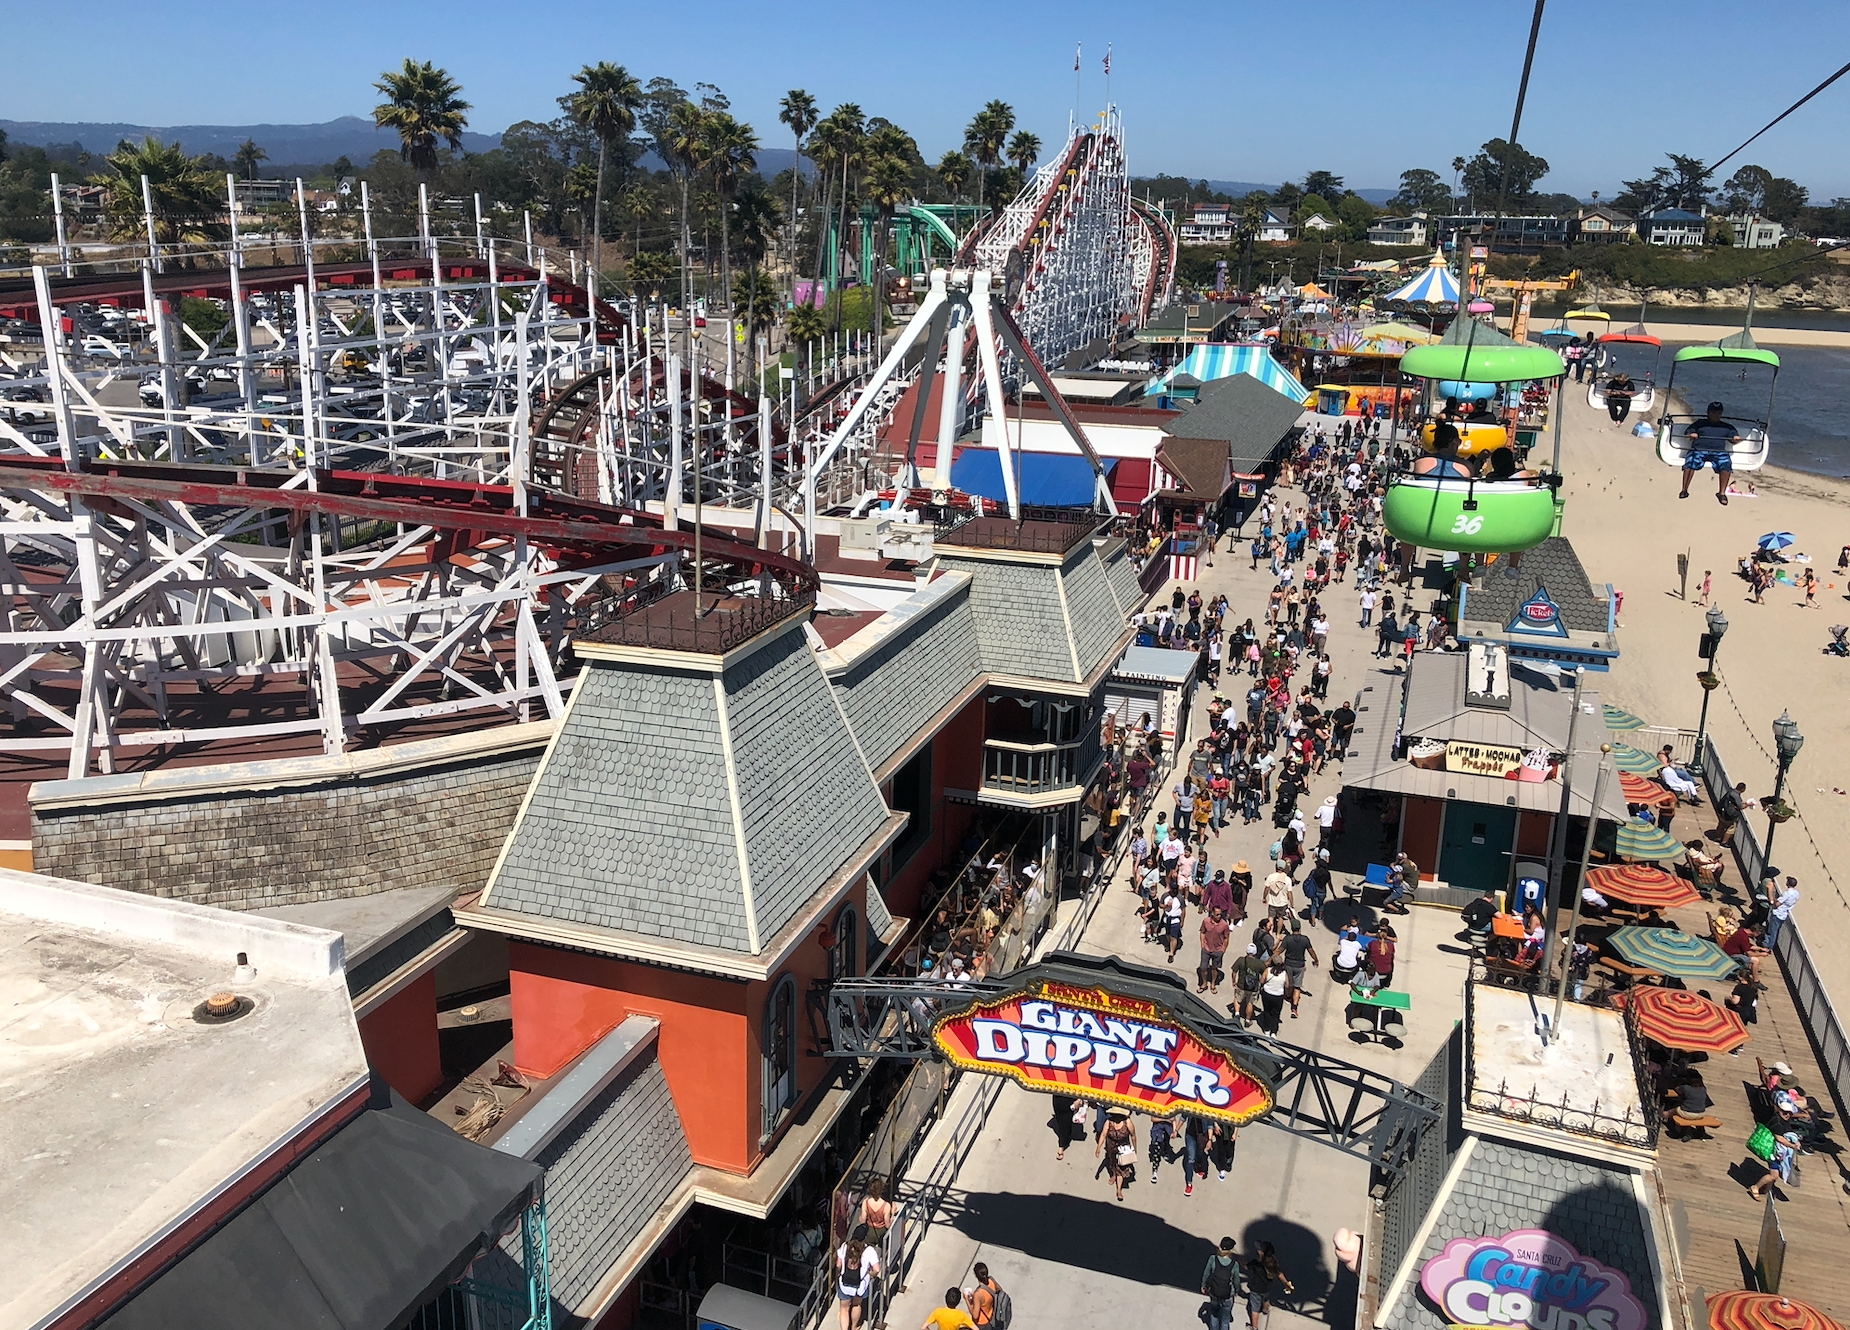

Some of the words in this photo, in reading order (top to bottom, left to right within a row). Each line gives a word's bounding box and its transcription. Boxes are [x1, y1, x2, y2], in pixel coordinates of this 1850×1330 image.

[1462, 390, 1473, 398] 34
[1451, 514, 1484, 535] 36
[1523, 605, 1556, 617] Tickets
[1126, 672, 1167, 680] PAINTING
[1448, 745, 1480, 759] LATTES
[1486, 749, 1521, 763] MOCHAS
[1048, 981, 1103, 1005] SANTA
[1109, 994, 1155, 1014] CRUZ
[1019, 1001, 1178, 1054] GIANT
[971, 1019, 1231, 1107] DIPPER
[1516, 1248, 1540, 1262] SANTA
[1542, 1255, 1562, 1267] CRUZ
[1467, 1248, 1606, 1307] Candy
